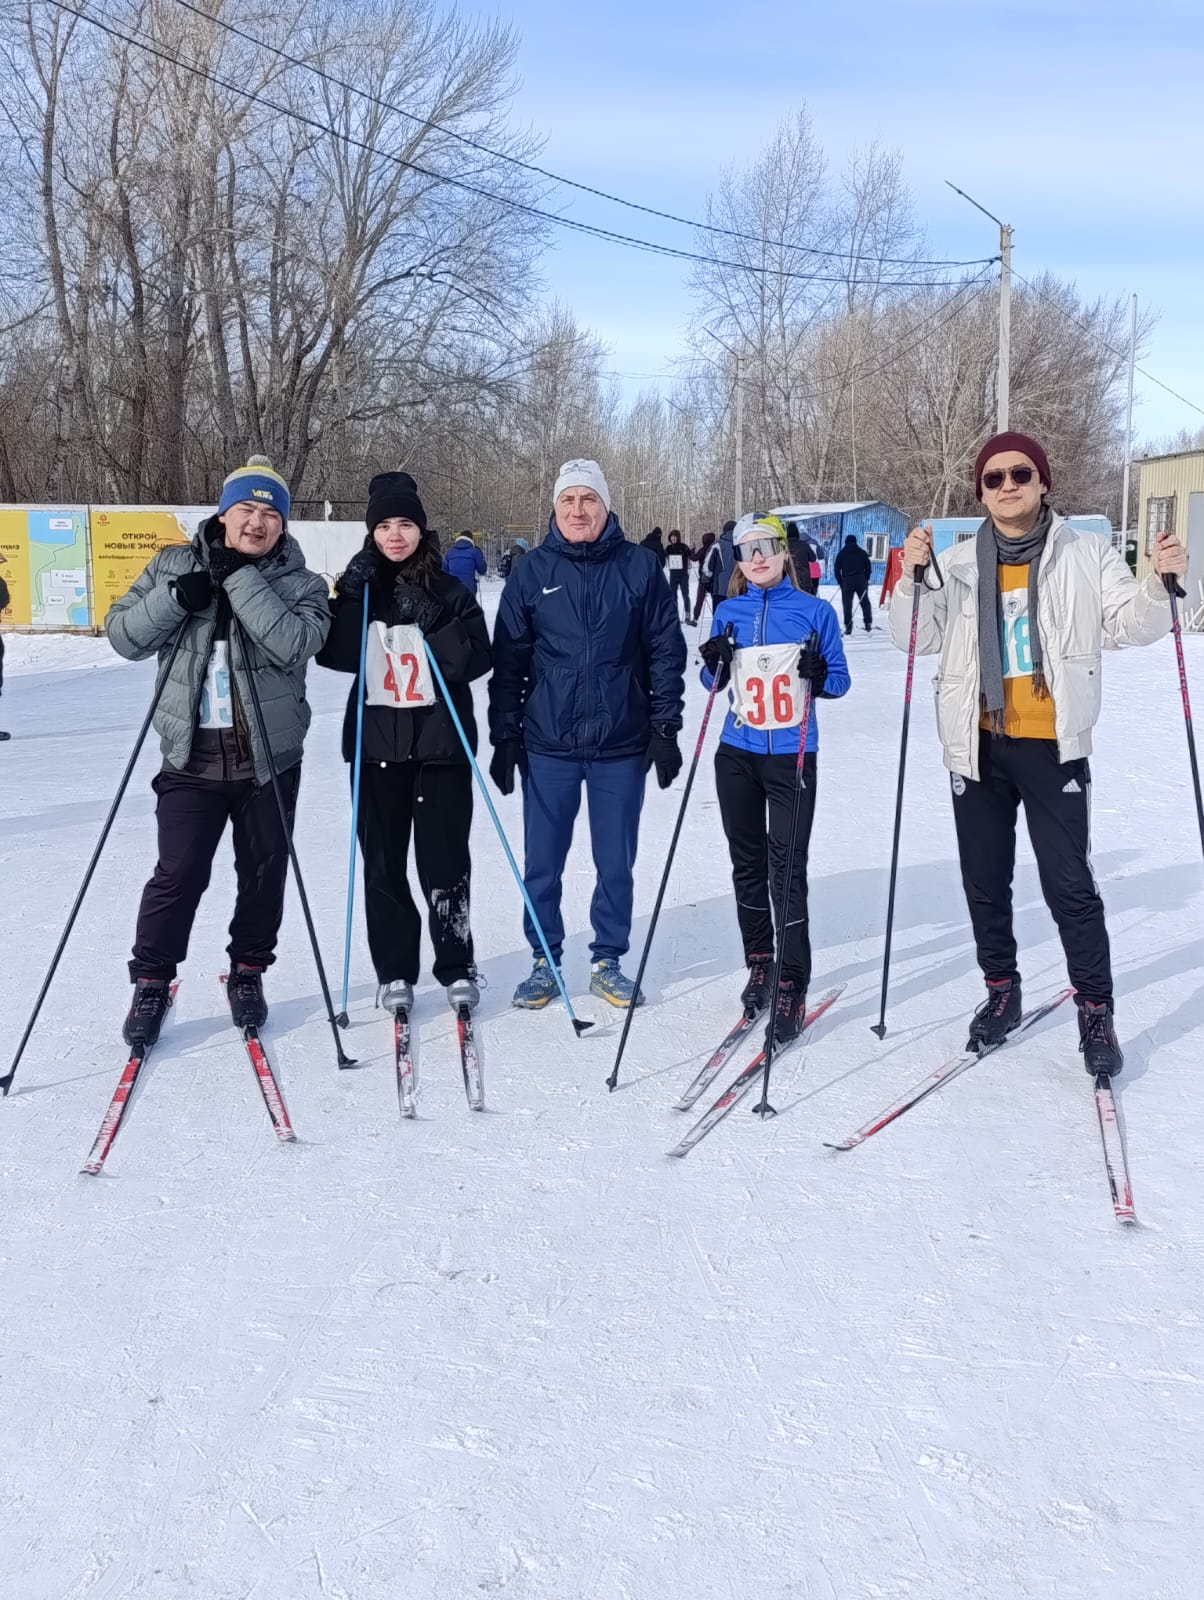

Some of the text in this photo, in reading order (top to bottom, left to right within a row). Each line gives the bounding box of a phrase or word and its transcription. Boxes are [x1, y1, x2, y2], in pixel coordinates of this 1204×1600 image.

[104, 542, 135, 550] НОВЫЕ
[122, 532, 157, 540] ОТКРОЙ
[383, 653, 425, 702] 42
[745, 674, 793, 725] 36
